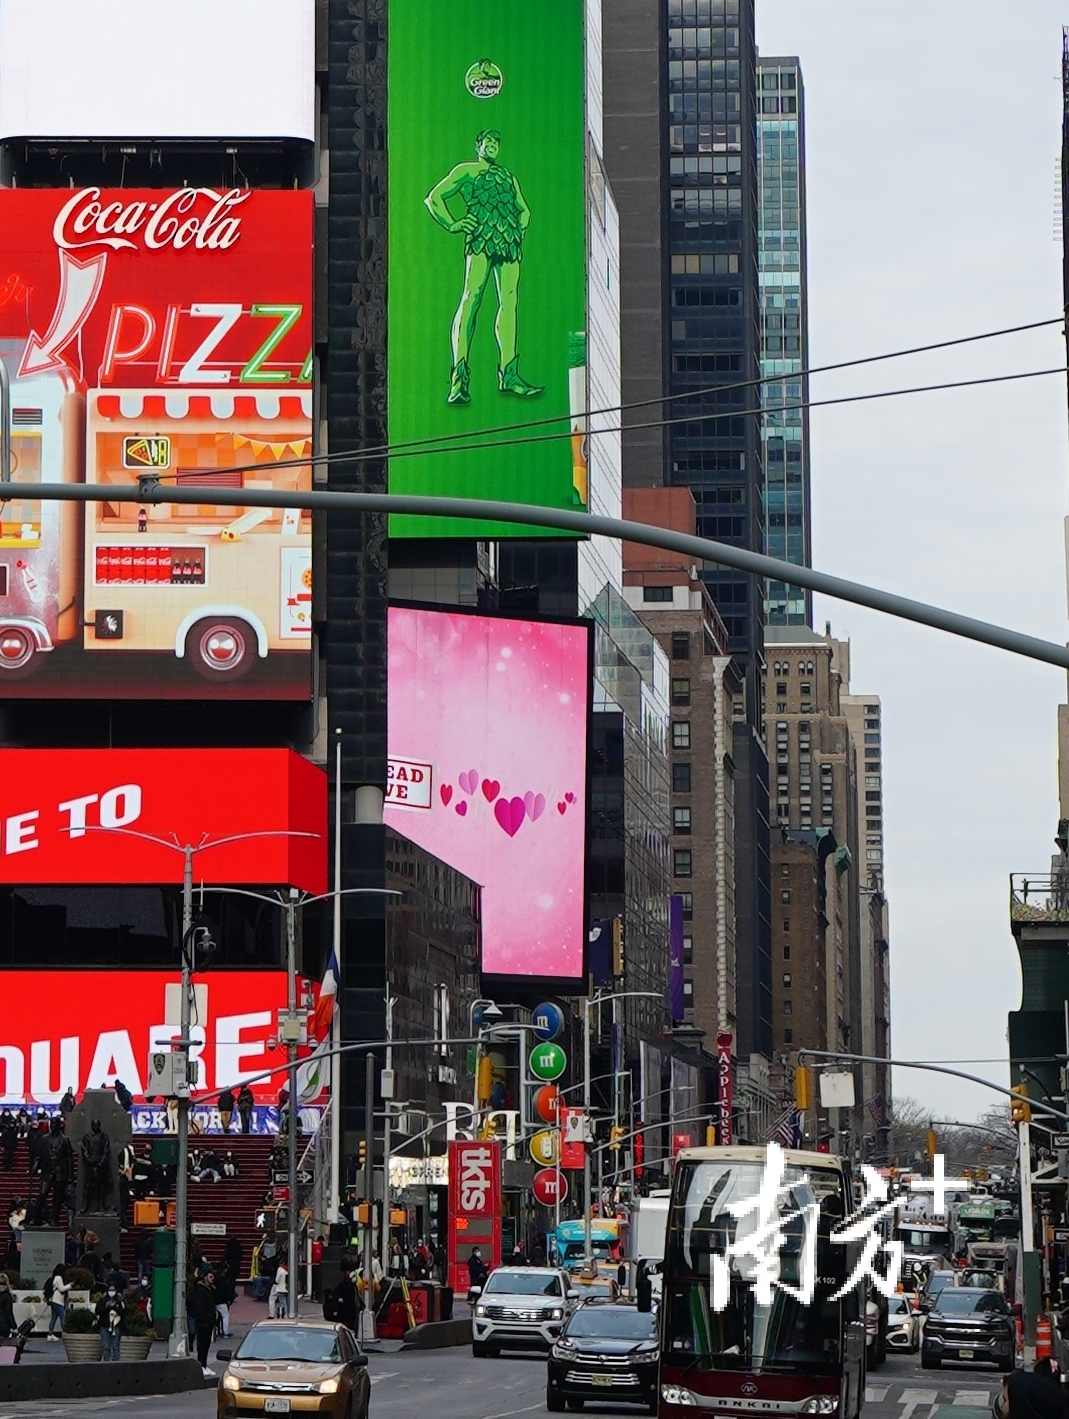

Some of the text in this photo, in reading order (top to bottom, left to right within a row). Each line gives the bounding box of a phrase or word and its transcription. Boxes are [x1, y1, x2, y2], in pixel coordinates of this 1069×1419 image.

[470, 78, 500, 87] Green
[474, 86, 501, 95] Giant
[52, 186, 252, 251] Coca-Cola
[386, 765, 424, 783] EAD
[384, 783, 408, 799] VE
[58, 783, 143, 838] TO
[461, 1147, 493, 1211] tkts
[718, 1399, 782, 1409] ANKAI
